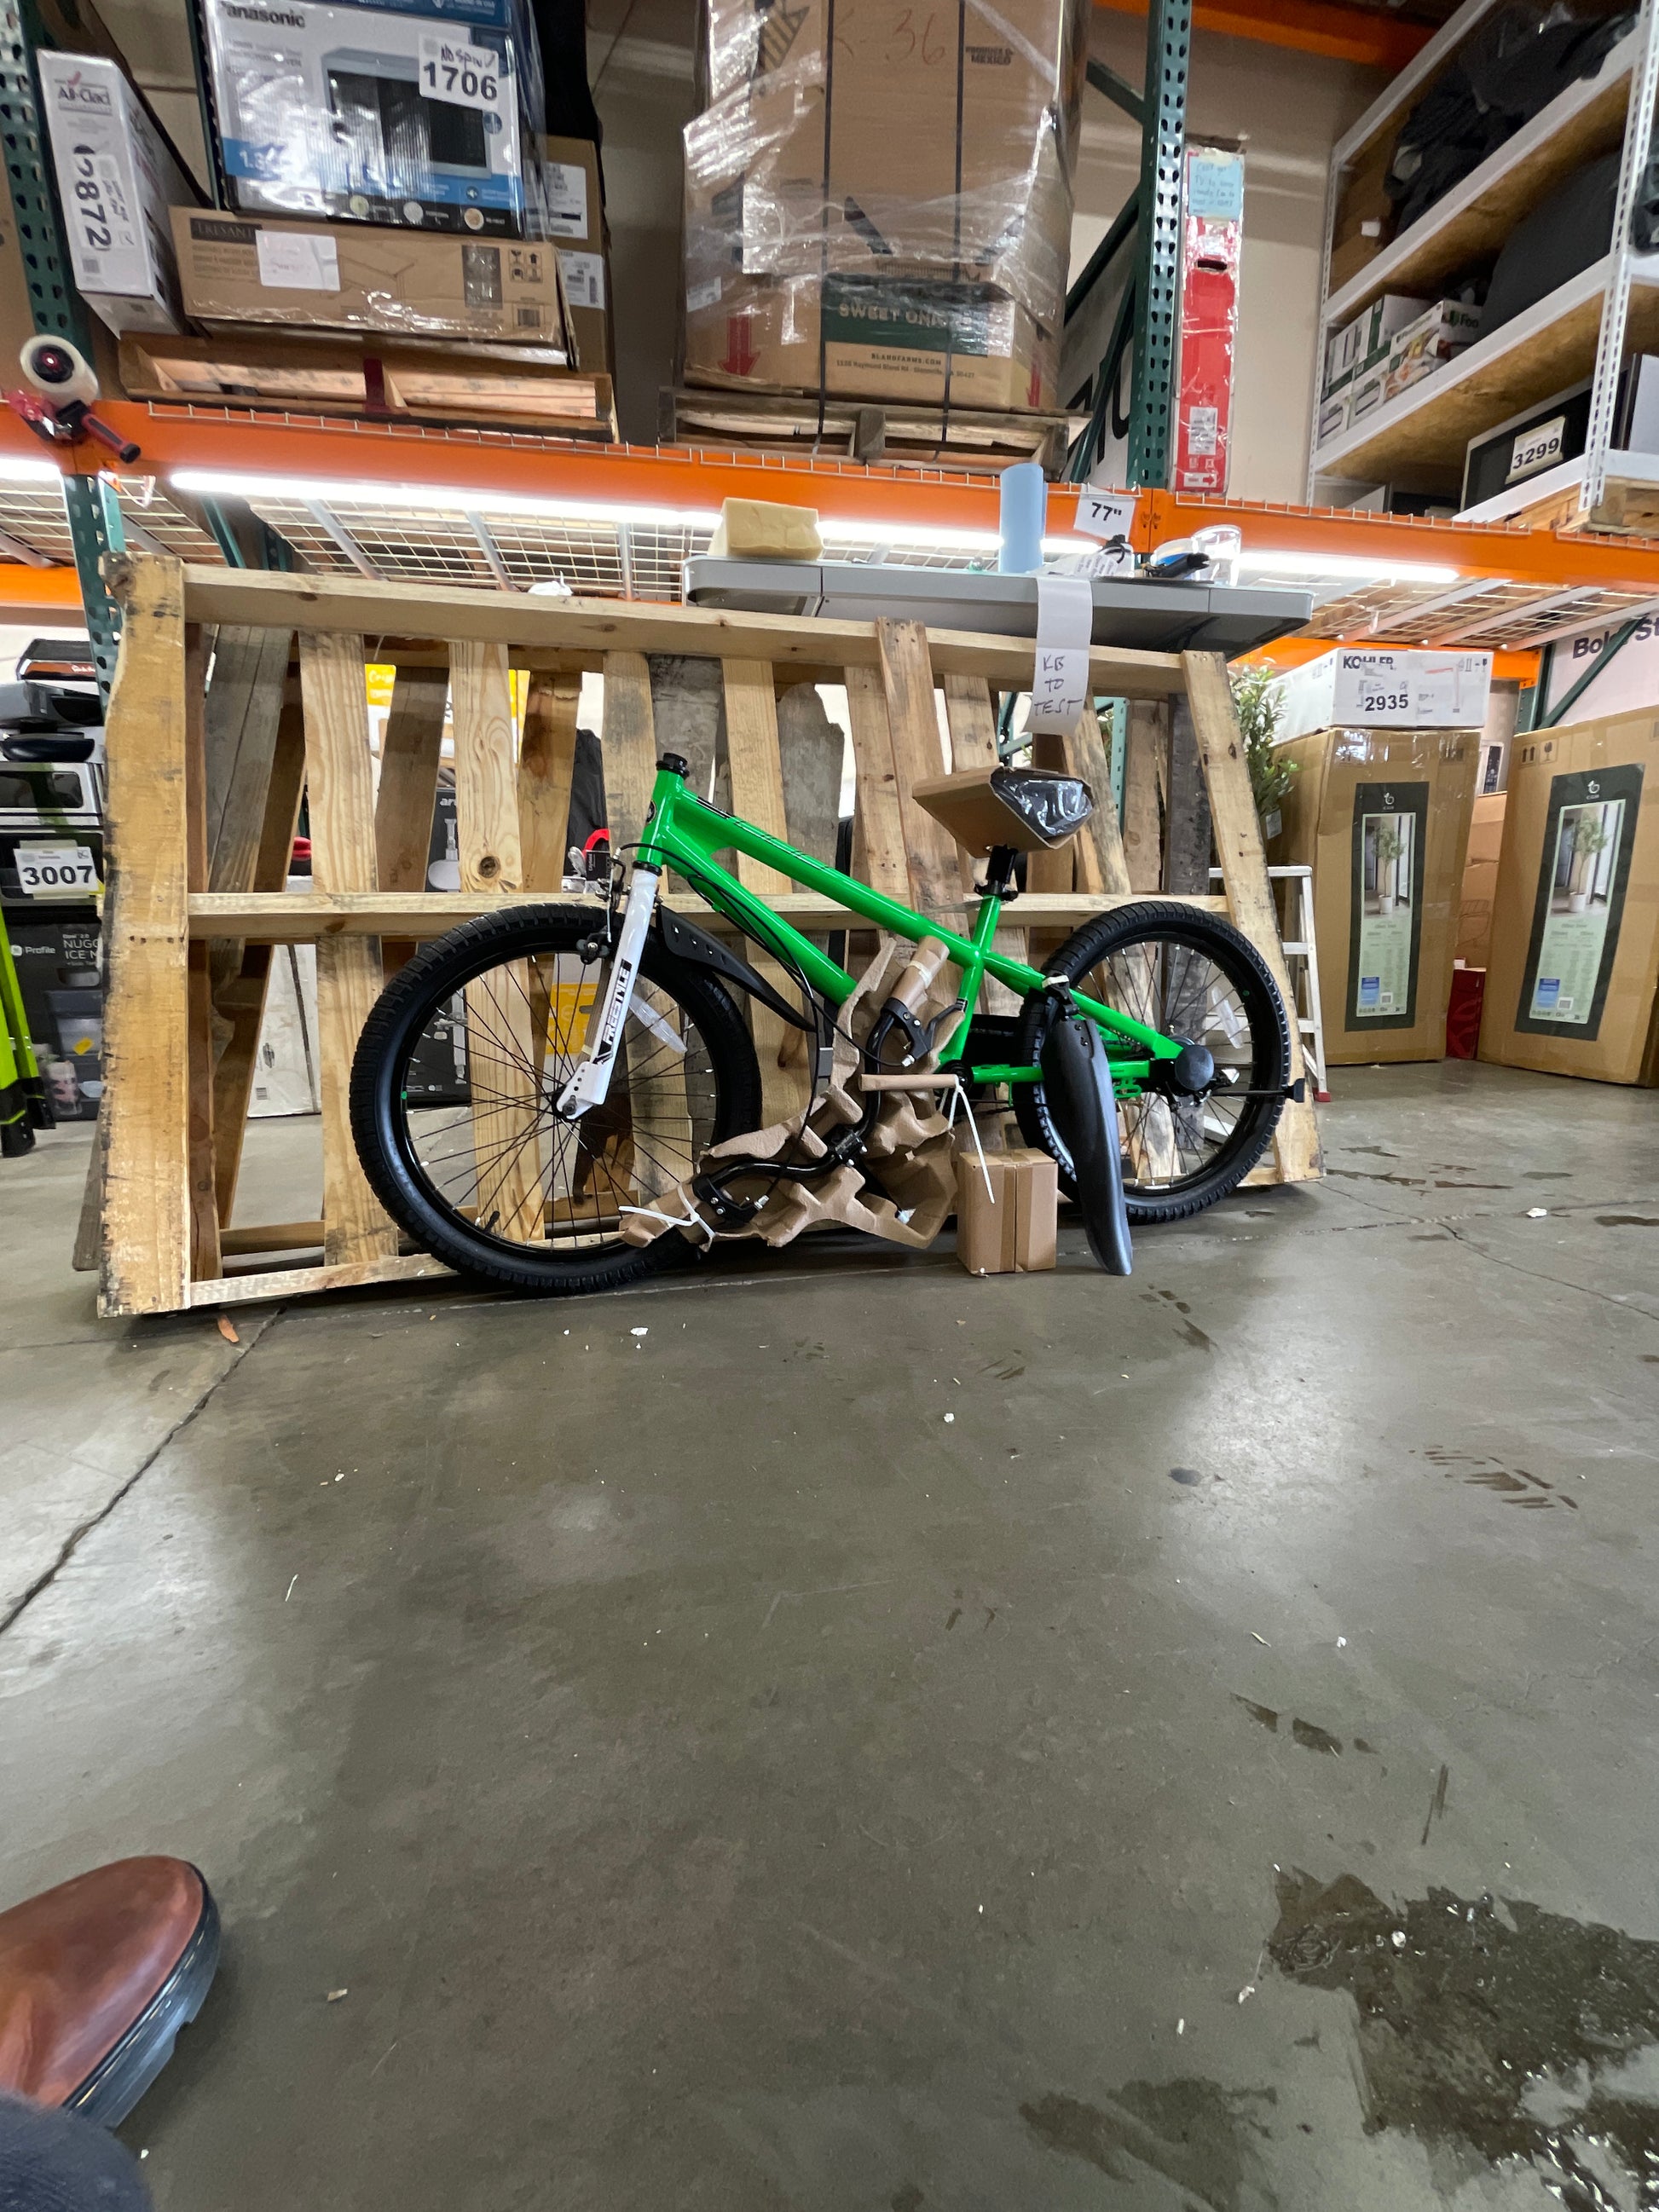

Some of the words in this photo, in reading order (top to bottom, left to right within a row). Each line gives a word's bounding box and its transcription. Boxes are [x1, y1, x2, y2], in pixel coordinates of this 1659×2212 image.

[221, 2, 305, 28] anasonic
[423, 61, 497, 101] 1706
[839, 303, 900, 322] SWEET
[1512, 437, 1560, 470] 3299
[1044, 678, 1065, 692] TO
[1034, 698, 1083, 716] TEST
[1364, 694, 1409, 712] 2935
[22, 865, 93, 886] 3007
[25, 945, 55, 955] Profile
[65, 950, 87, 960] ICE
